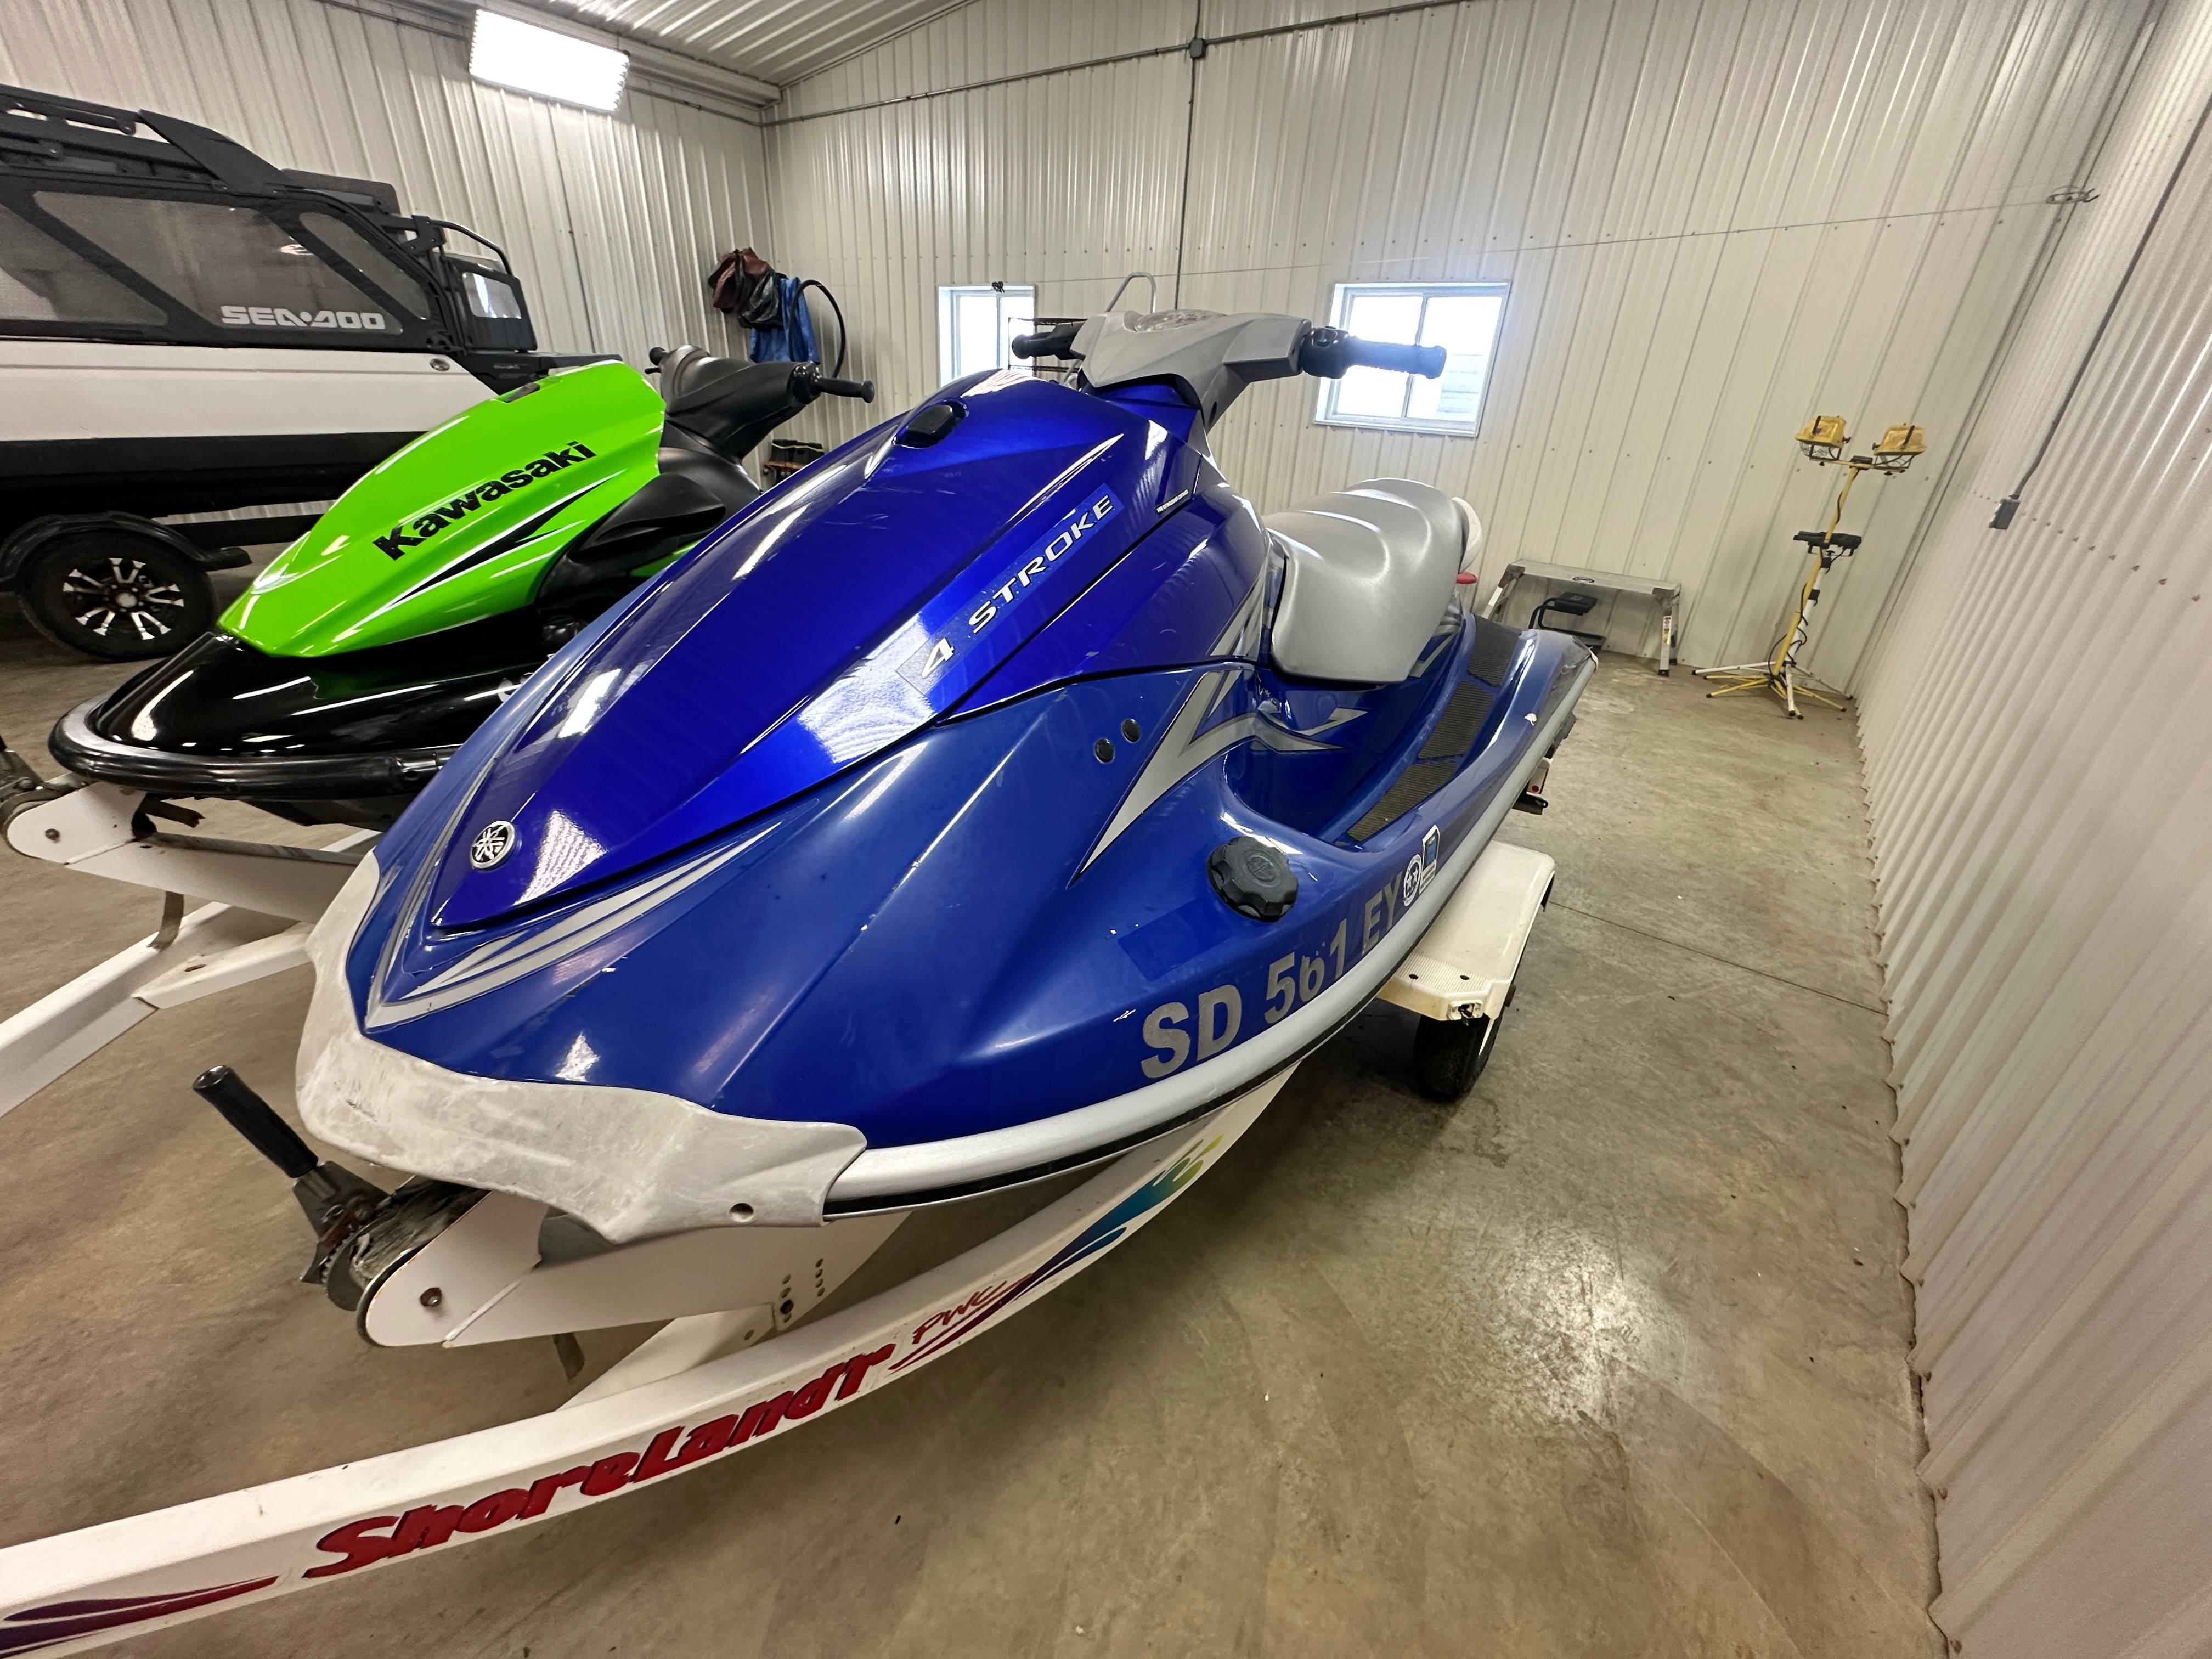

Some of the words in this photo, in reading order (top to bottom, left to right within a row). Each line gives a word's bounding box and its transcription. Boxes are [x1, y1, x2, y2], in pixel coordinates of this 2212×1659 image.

[373, 441, 596, 560] Kawasaki
[921, 637, 955, 679] 4
[969, 495, 1114, 633] STROKE
[1142, 985, 1242, 1078] SD
[1363, 871, 1402, 954] EY
